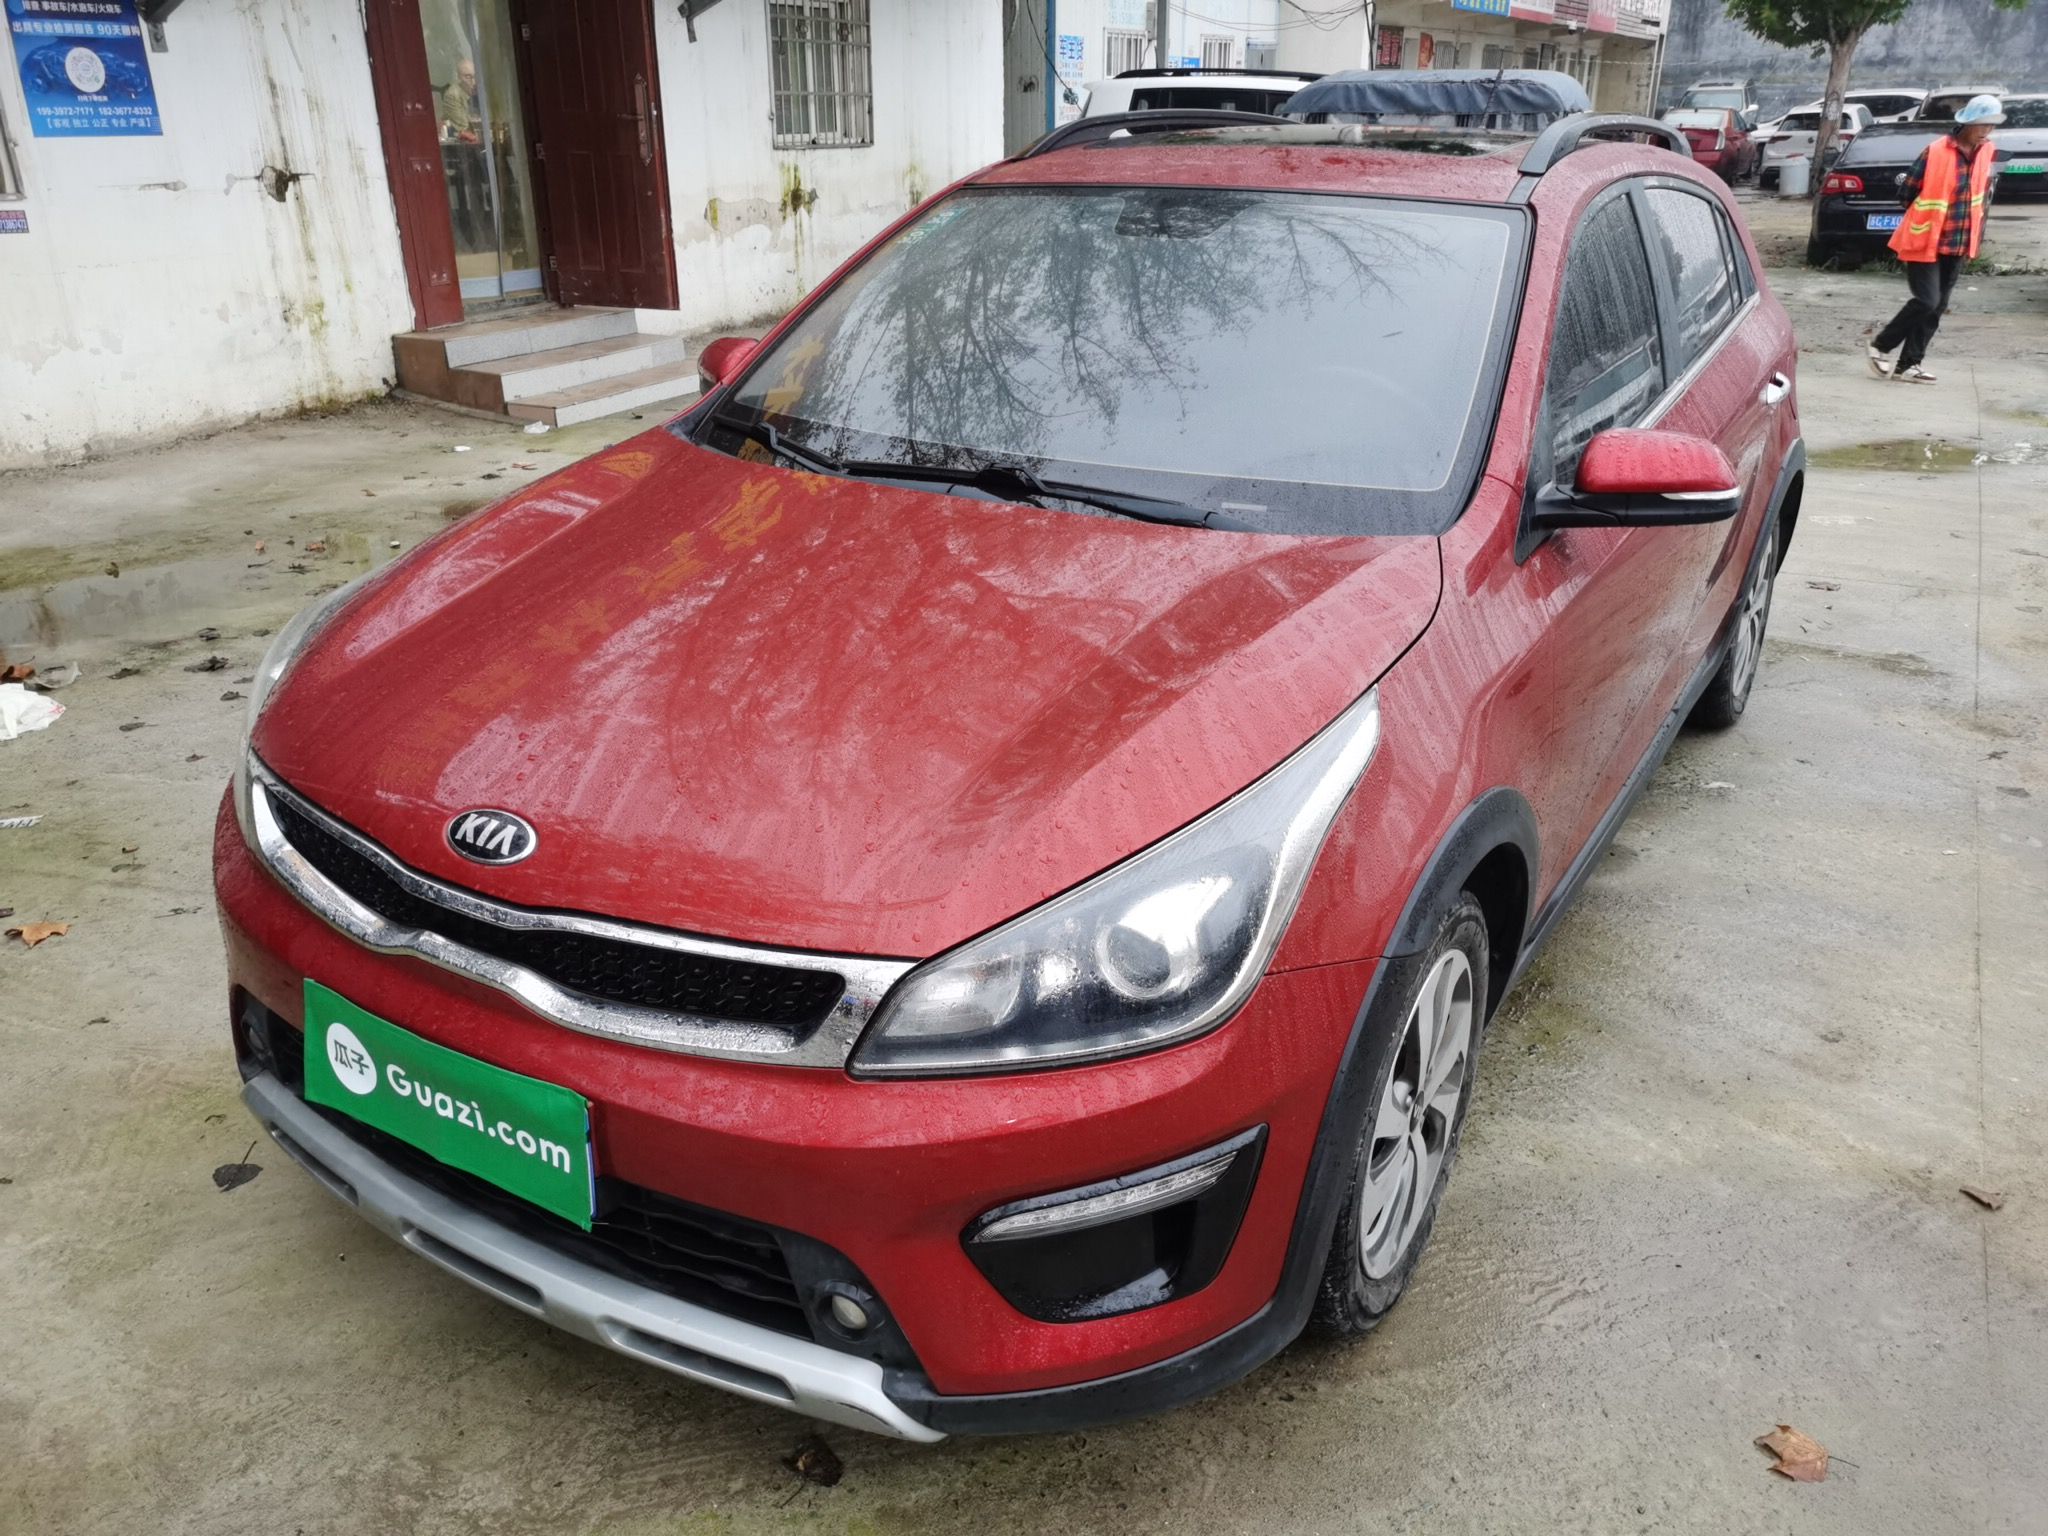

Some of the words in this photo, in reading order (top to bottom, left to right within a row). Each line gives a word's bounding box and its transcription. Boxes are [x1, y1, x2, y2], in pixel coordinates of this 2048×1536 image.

[455, 813, 518, 856] KIA
[334, 1039, 370, 1076] 瓜子
[386, 1063, 571, 1174] Guazi.com
